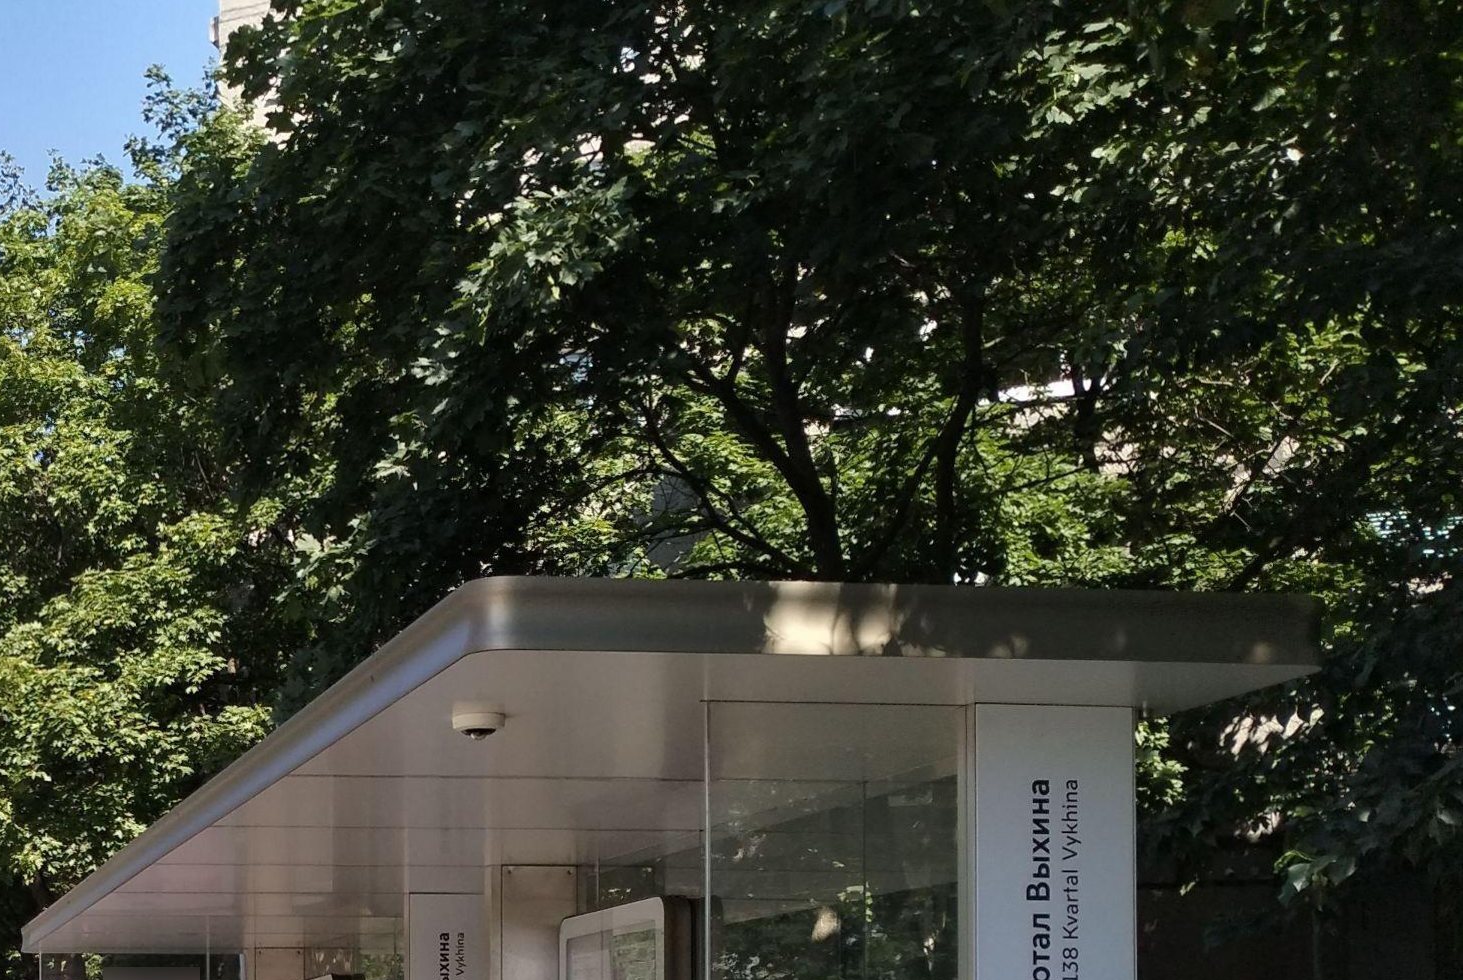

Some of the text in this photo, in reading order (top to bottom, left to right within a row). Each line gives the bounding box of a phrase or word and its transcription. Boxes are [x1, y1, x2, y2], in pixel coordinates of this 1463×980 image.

[1026, 779, 1051, 901] Выхина
[1061, 779, 1082, 861] Vykhina
[1062, 870, 1079, 939] Kvartal
[455, 932, 466, 977] Vykhina
